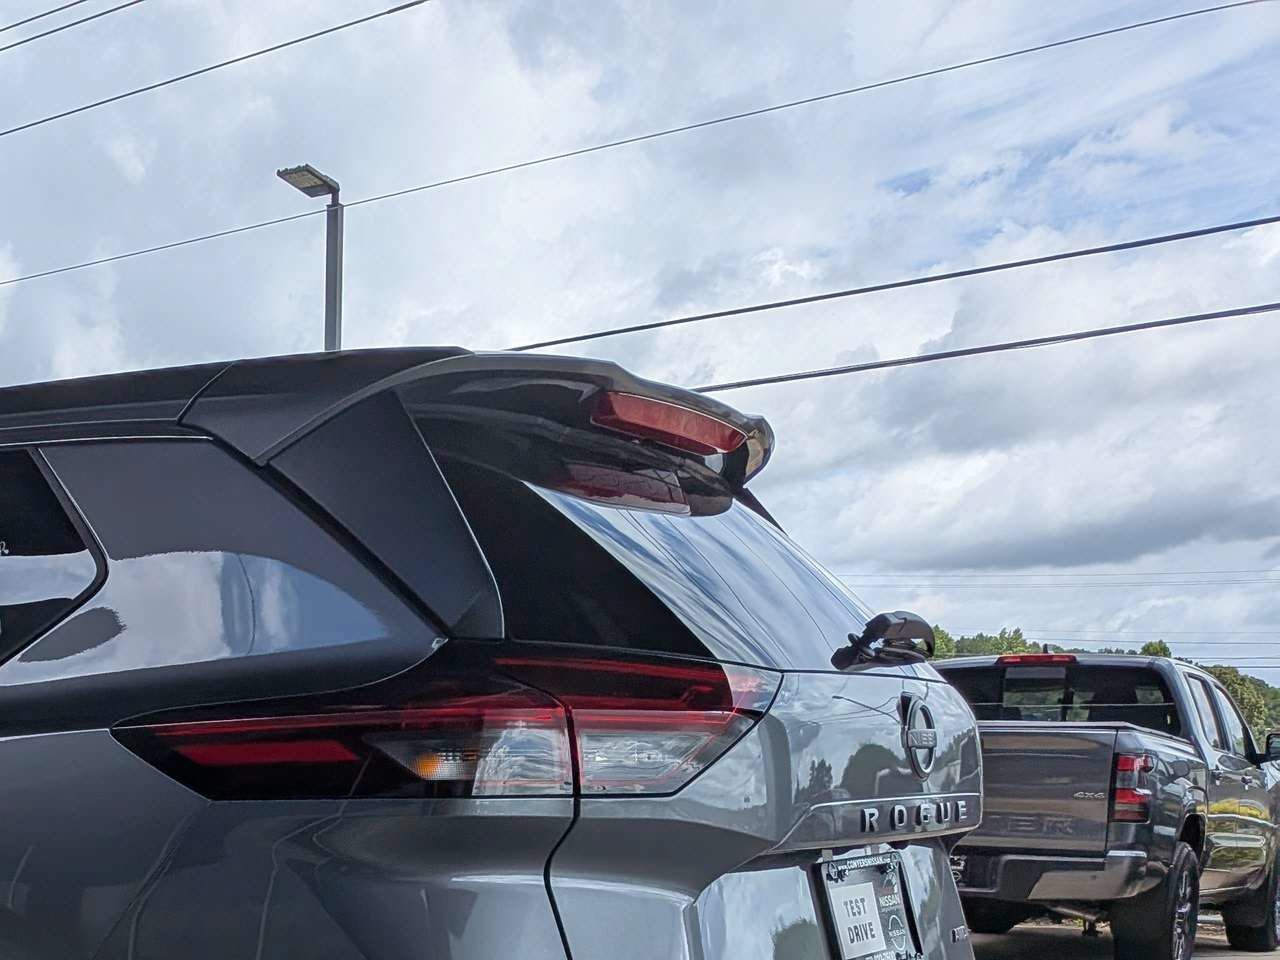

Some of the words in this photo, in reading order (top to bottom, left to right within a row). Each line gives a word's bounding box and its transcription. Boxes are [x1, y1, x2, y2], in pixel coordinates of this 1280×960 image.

[861, 800, 968, 833] ROGUE
[843, 897, 866, 918] TEST
[847, 921, 876, 944] DRIVE
